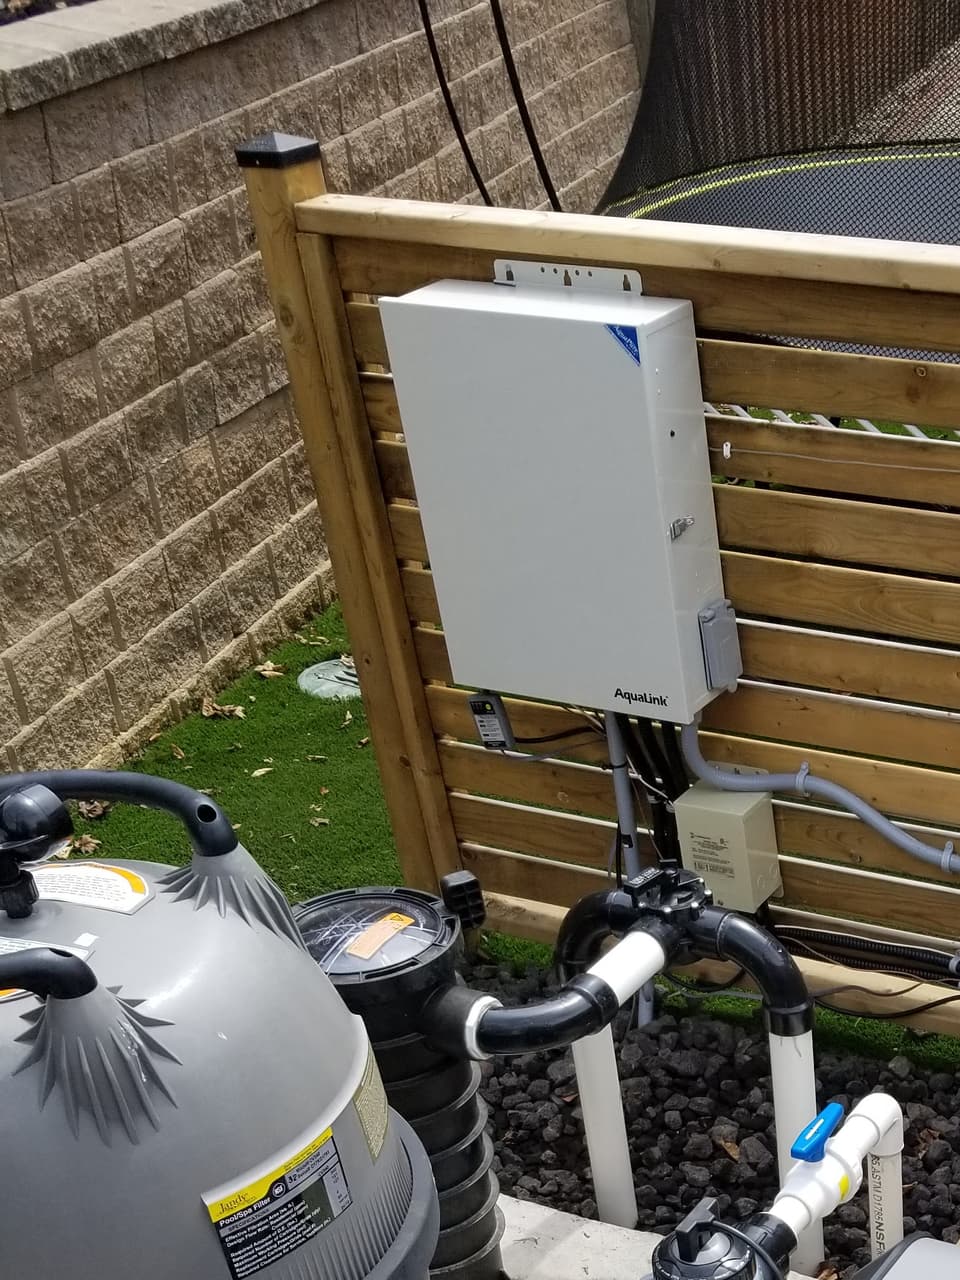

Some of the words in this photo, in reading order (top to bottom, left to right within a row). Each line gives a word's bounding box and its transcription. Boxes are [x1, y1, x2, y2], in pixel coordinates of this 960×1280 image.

[614, 687, 668, 706] AquaLink
[219, 1207, 253, 1227] Pool/Spa
[253, 1197, 270, 1210] Filter
[874, 1220, 886, 1251] NSF
